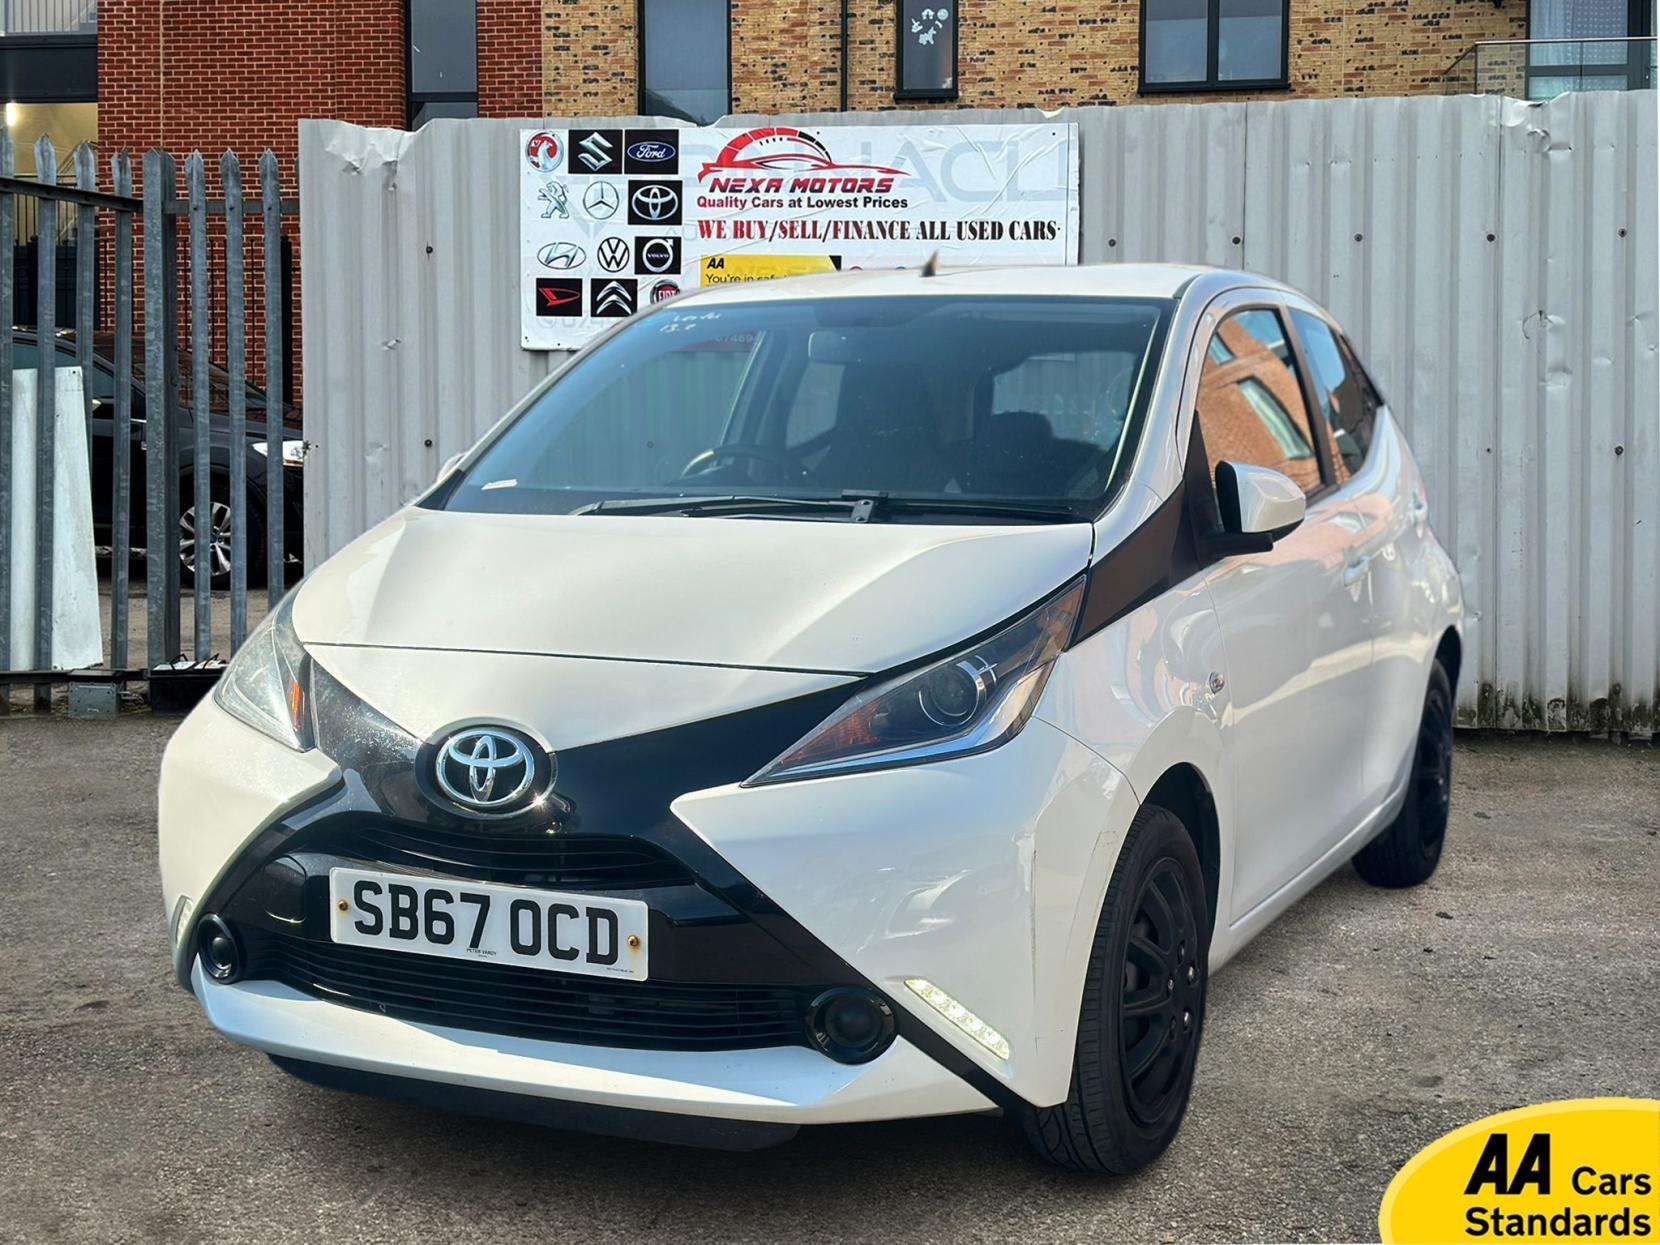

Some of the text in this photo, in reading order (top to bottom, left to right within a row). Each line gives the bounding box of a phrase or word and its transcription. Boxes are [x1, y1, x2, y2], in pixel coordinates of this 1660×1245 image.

[636, 144, 666, 159] Ford
[709, 177, 894, 193] NEXA MOTORS
[697, 195, 908, 210] Quality Cars at Lowest Prices
[697, 220, 726, 239] WE
[732, 220, 911, 242] BUY/SELL/FINANCE
[915, 220, 951, 239] ALL
[956, 220, 1003, 239] USED
[707, 257, 725, 269] AA
[706, 273, 741, 284] You're
[353, 879, 619, 966] SB67 OCD
